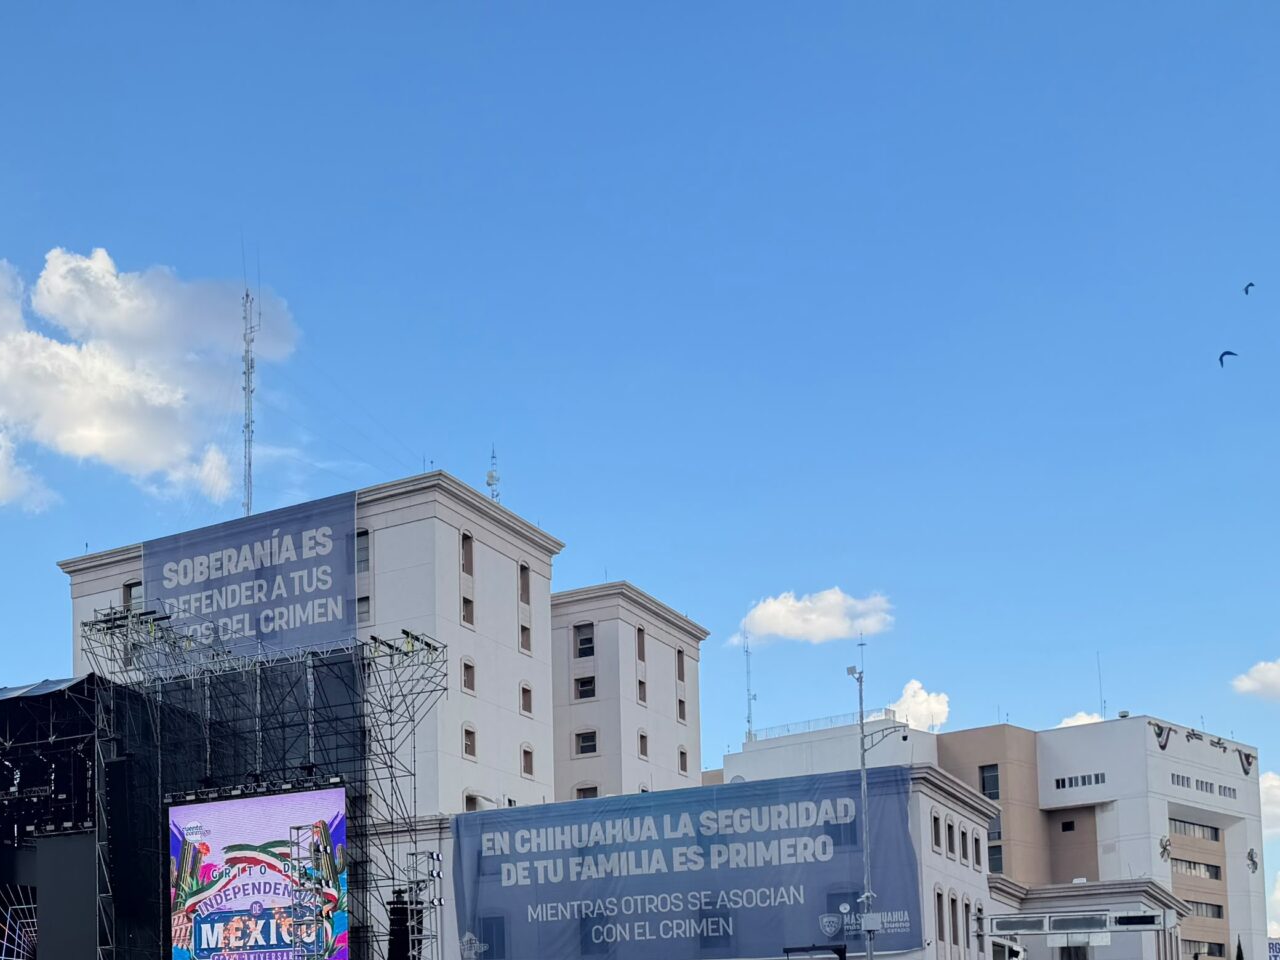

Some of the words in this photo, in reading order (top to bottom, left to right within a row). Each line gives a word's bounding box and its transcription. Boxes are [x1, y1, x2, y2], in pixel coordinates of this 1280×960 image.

[162, 529, 298, 589] SOBERANÍA
[303, 526, 334, 559] ES
[271, 577, 287, 599] A
[290, 565, 332, 595] TUS
[218, 613, 256, 642] DEL
[260, 596, 343, 633] CRIMEN
[481, 829, 510, 857] EN
[514, 815, 658, 854] CHIHUAHUA
[663, 812, 695, 840] LA
[700, 797, 856, 837] SEGURIDAD
[210, 864, 268, 880] GRITO
[501, 860, 532, 887] DE
[535, 857, 564, 884] TU
[569, 846, 668, 881] FAMILIA
[673, 844, 705, 872] ES
[710, 835, 834, 870] PRIMERO
[252, 904, 262, 914] DE
[527, 896, 618, 922] MIENTRAS
[621, 893, 683, 915] OTROS
[688, 891, 713, 911] SE
[716, 885, 805, 909] ASOCIAN
[591, 923, 630, 944] CON
[635, 921, 657, 941] EL
[659, 917, 734, 940] CRIMEN
